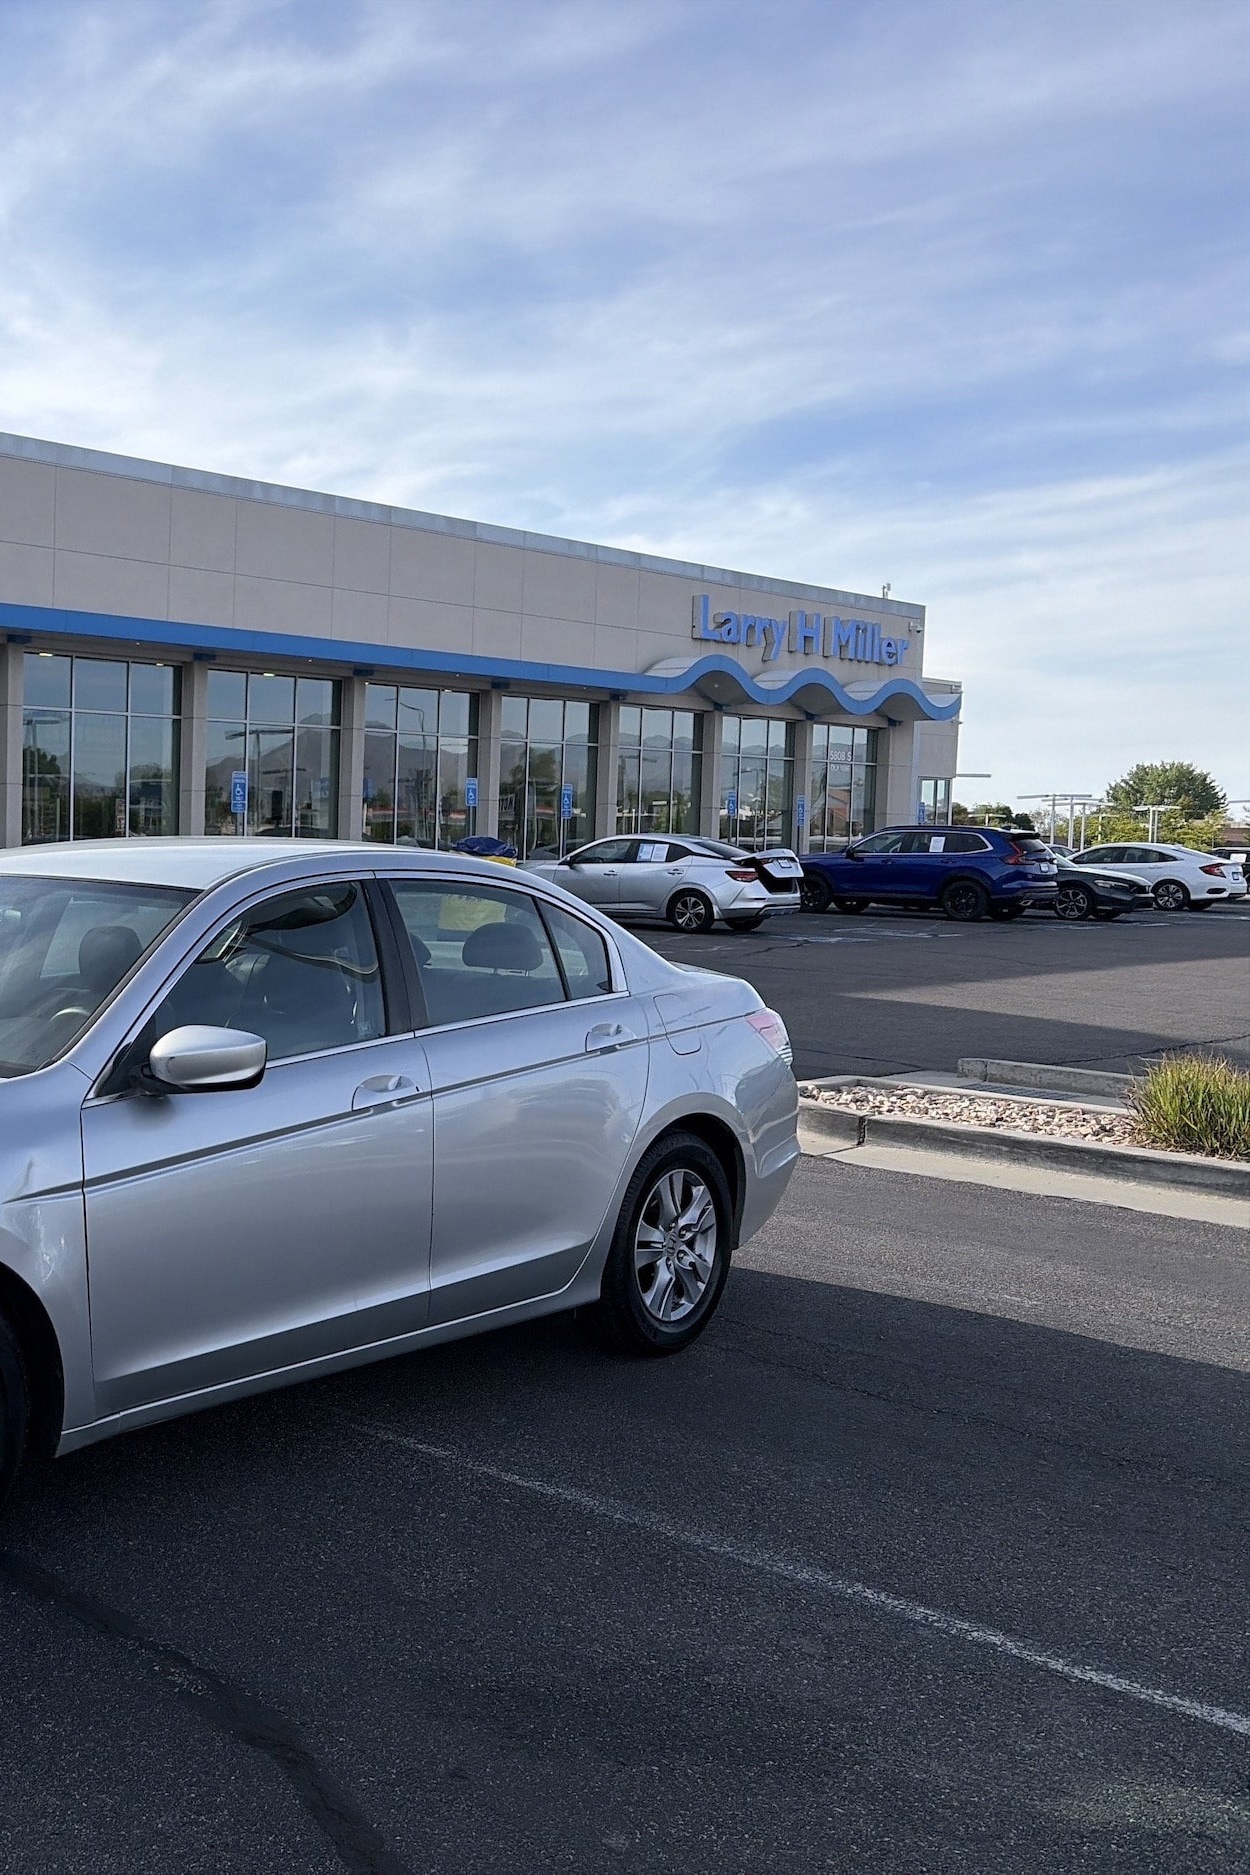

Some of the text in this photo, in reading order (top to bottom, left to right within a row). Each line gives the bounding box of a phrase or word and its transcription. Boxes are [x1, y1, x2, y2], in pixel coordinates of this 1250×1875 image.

[693, 594, 910, 666] Larry H Miller
